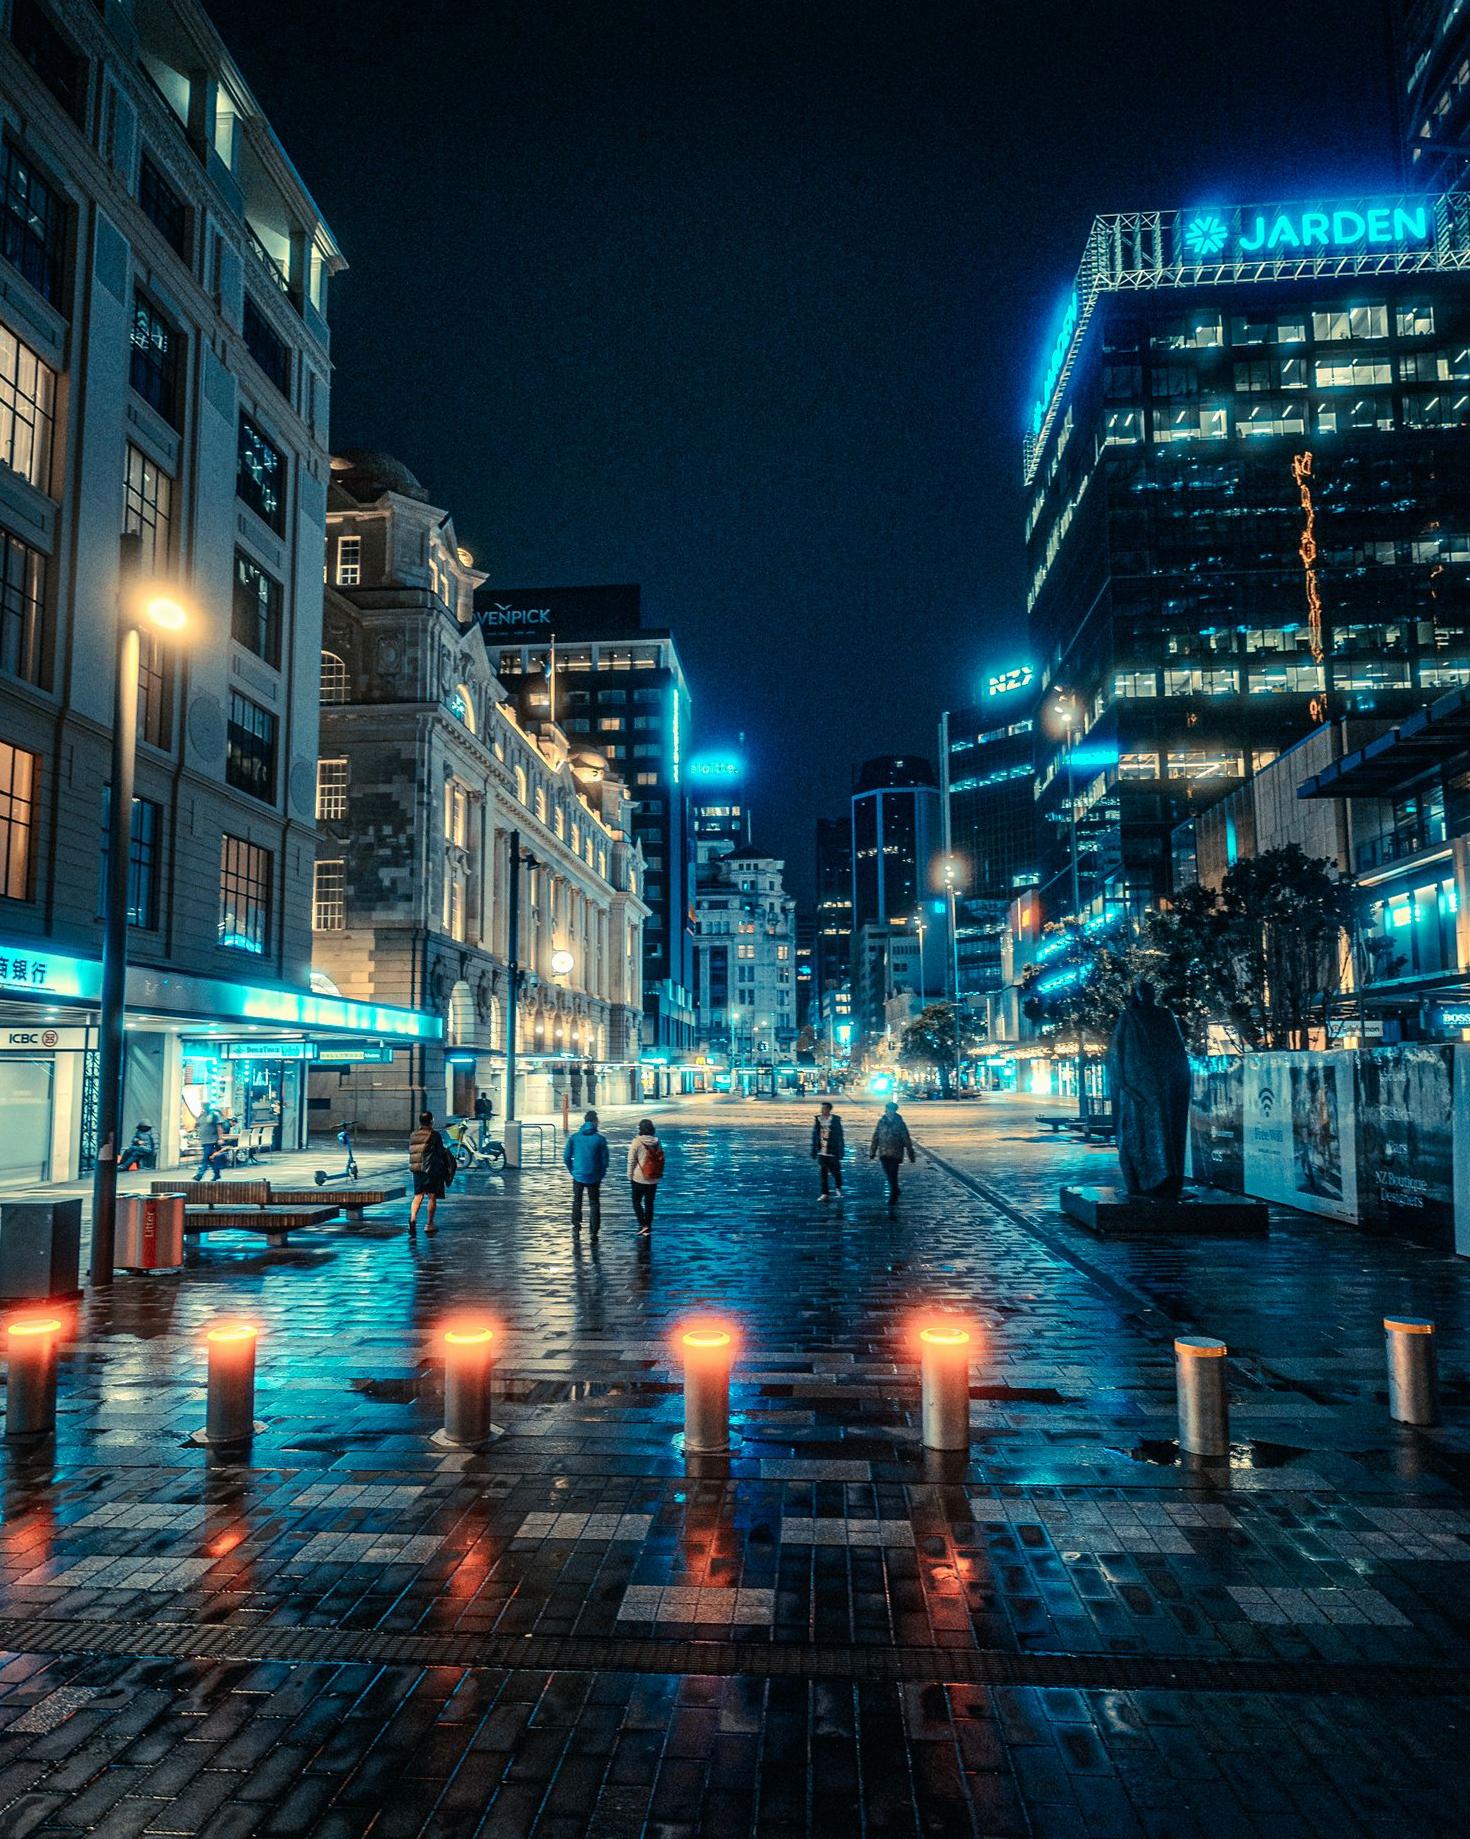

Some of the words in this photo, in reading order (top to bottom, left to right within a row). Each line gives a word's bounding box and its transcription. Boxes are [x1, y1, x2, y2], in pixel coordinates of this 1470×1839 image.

[1240, 207, 1426, 250] JARDEN
[475, 608, 551, 625] VENPICK
[9, 1033, 38, 1044] ICBC
[1375, 1170, 1387, 1185] NZ
[1388, 1172, 1428, 1192] Boutique
[1380, 1187, 1424, 1209] Designers
[144, 1212, 155, 1238] Litter
